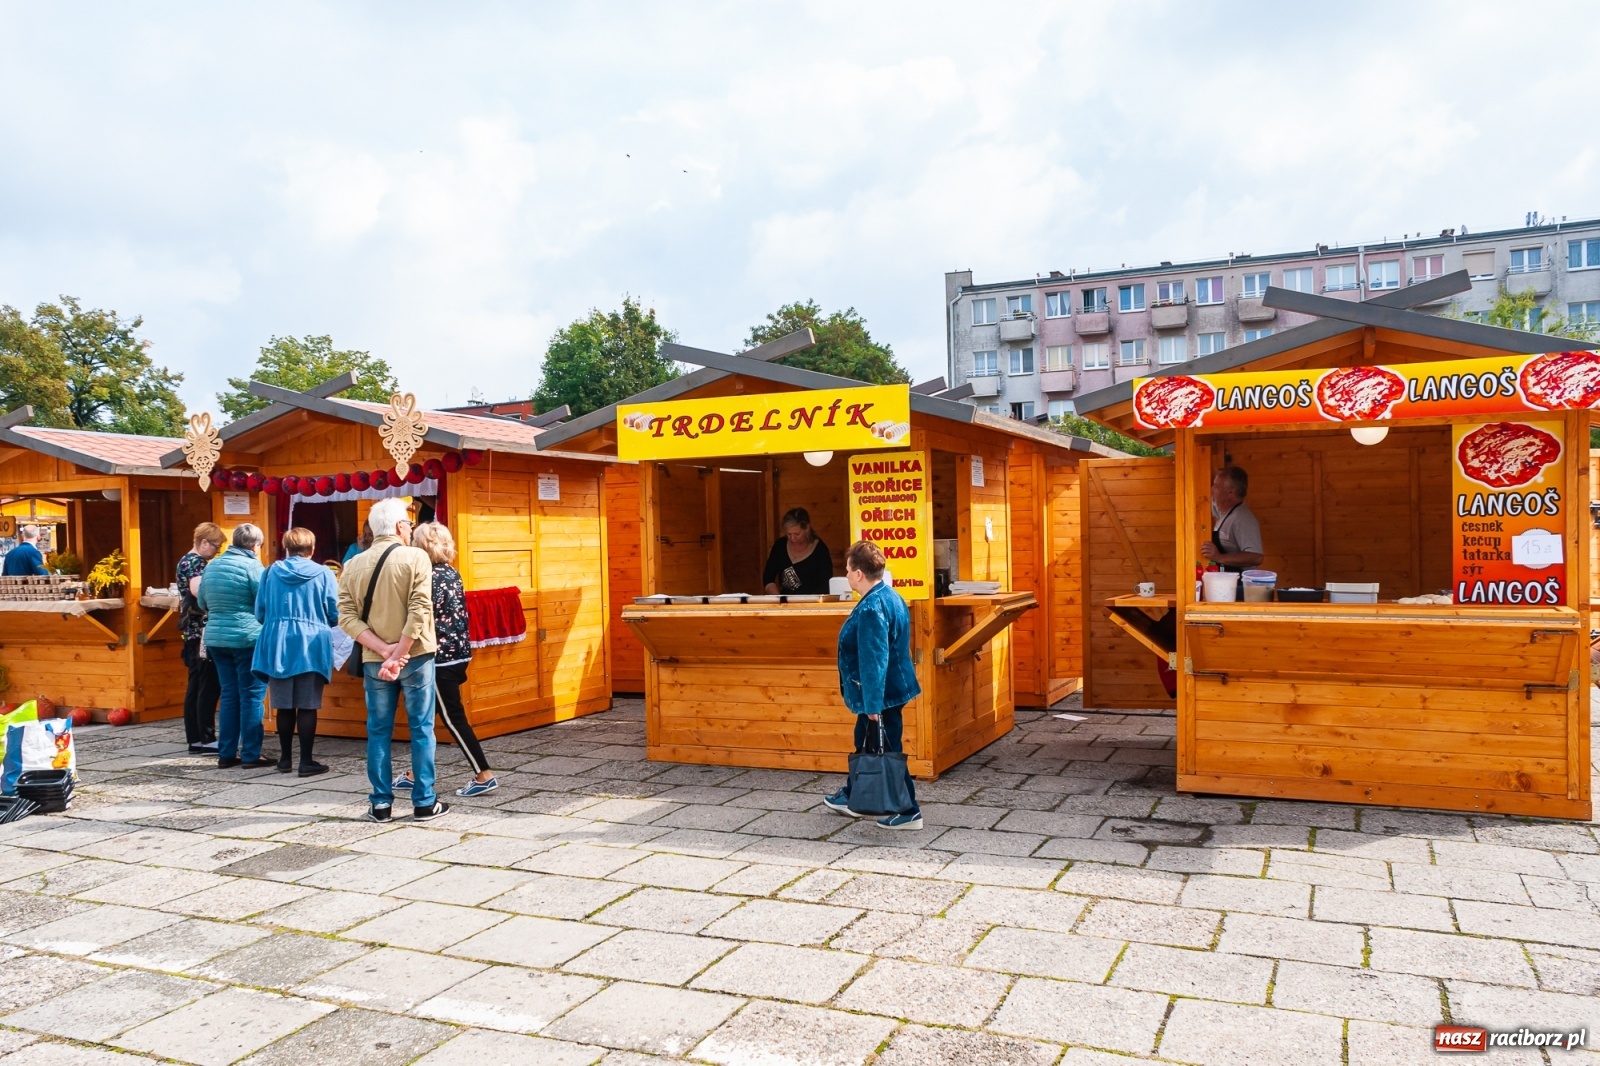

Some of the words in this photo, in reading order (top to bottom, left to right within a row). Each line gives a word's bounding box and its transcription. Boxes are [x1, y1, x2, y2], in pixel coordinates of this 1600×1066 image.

[1216, 379, 1313, 411] LANGOŠ
[1409, 366, 1517, 402] LANGOŠ
[649, 398, 875, 439] TRDELNÍK
[852, 459, 922, 475] VANILKA
[853, 477, 922, 494] SKOŘICE
[858, 493, 917, 505] (CINNAMON)
[1457, 488, 1561, 517] LANGOŠ
[861, 507, 915, 522] OŘECH
[1461, 520, 1504, 532] česnek
[861, 527, 916, 541] KOKOS
[1462, 535, 1501, 549] kečup
[1520, 540, 1541, 555] 15
[884, 546, 917, 559] KAO
[1462, 548, 1511, 561] tatarka
[1462, 563, 1484, 577] sýr
[1458, 578, 1561, 605] LANGOŠ
